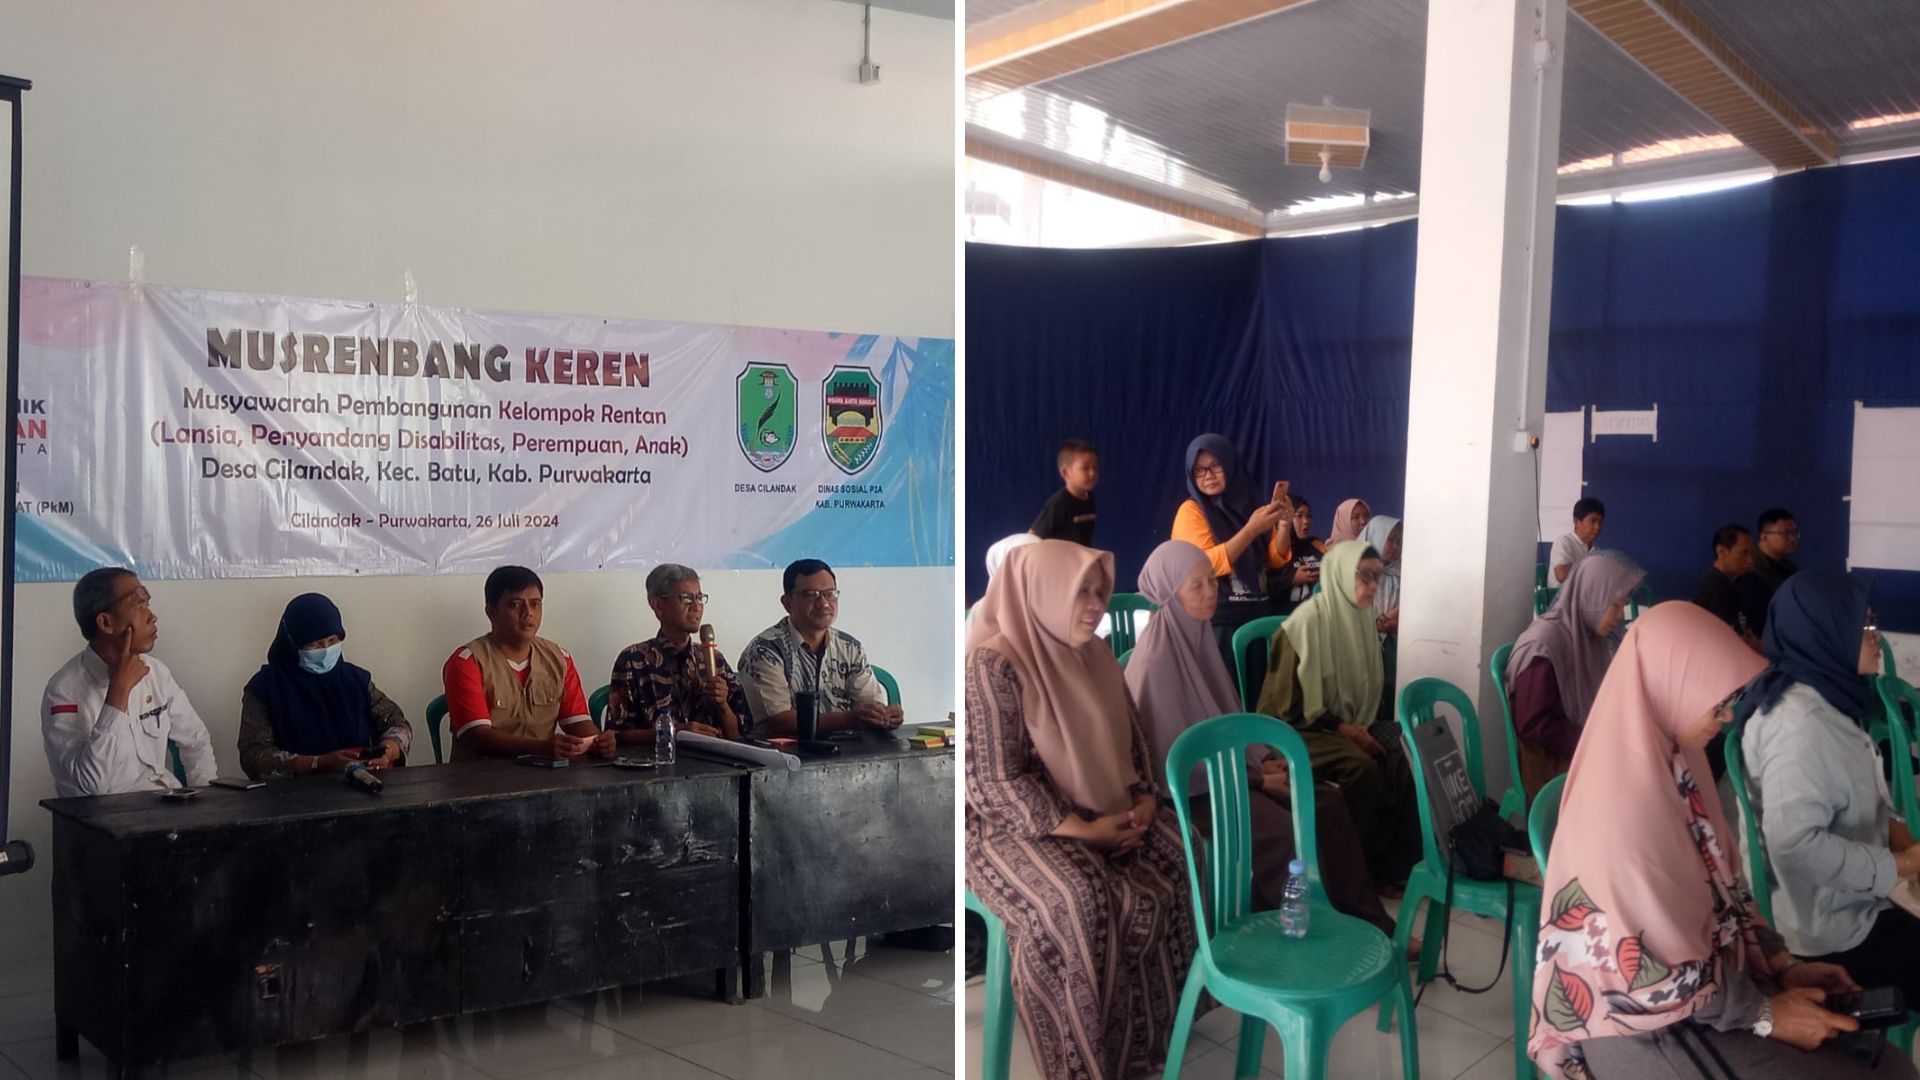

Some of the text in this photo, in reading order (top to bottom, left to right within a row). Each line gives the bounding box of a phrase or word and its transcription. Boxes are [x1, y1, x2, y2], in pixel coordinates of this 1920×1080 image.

[207, 327, 650, 388] MUSRENBANG KEREN
[183, 387, 667, 425] Musyawarah Pembangunan Kelompok Rentan
[150, 424, 689, 457] (Lansia, Penyandang Disabilitas, Perempuan, Anak)
[201, 457, 651, 485] Desa Cilandak, Kec. Batu, Kab. Purwakarta
[734, 483, 797, 494] DESA CILANDAK
[818, 484, 839, 494] DINAS
[840, 485, 868, 495] SOSIAL
[36, 501, 74, 516] (PkM)
[815, 499, 885, 510] KAB. PURWAKARTA
[290, 512, 361, 528] Cilandak
[379, 513, 472, 530] Purwakarta,
[475, 514, 492, 529] 26
[496, 513, 520, 529] Juli
[524, 514, 559, 528] 2024
